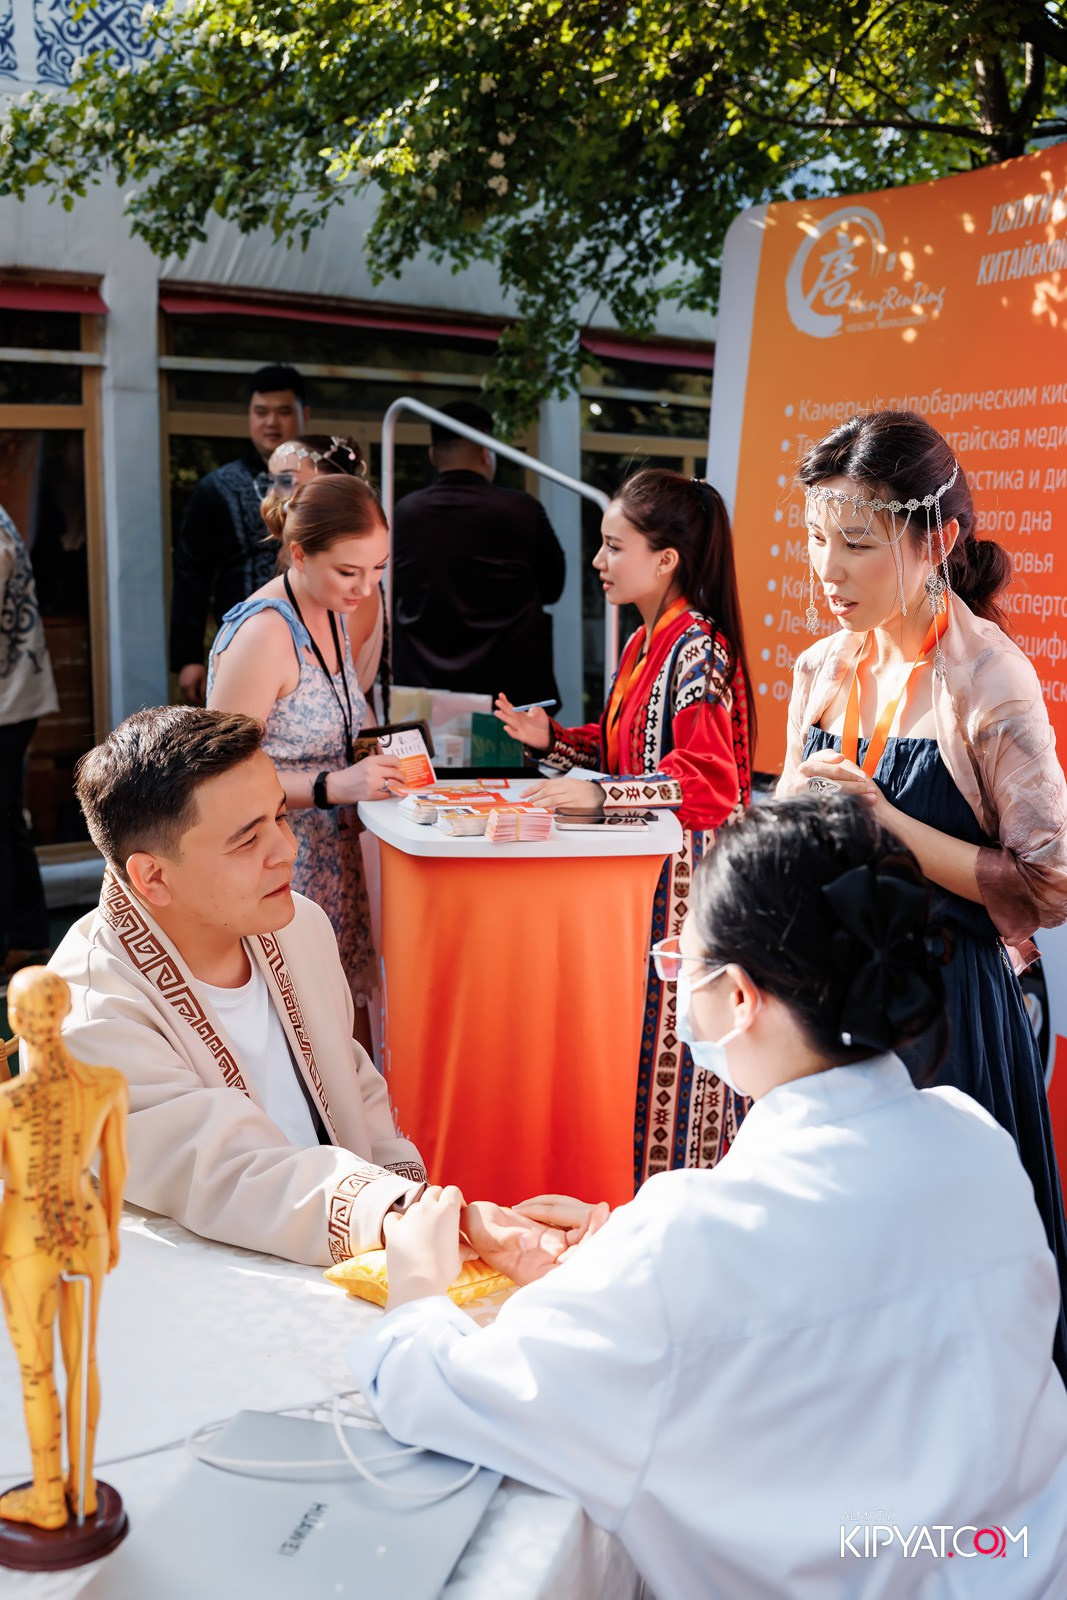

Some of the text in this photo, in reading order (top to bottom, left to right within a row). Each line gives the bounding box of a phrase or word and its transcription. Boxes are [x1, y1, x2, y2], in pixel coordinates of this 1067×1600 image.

[798, 399, 869, 421] Камеры
[889, 386, 1038, 419] гипобарическим
[965, 468, 1025, 491] остика
[1028, 469, 1040, 490] и
[976, 510, 1052, 535] вого дна
